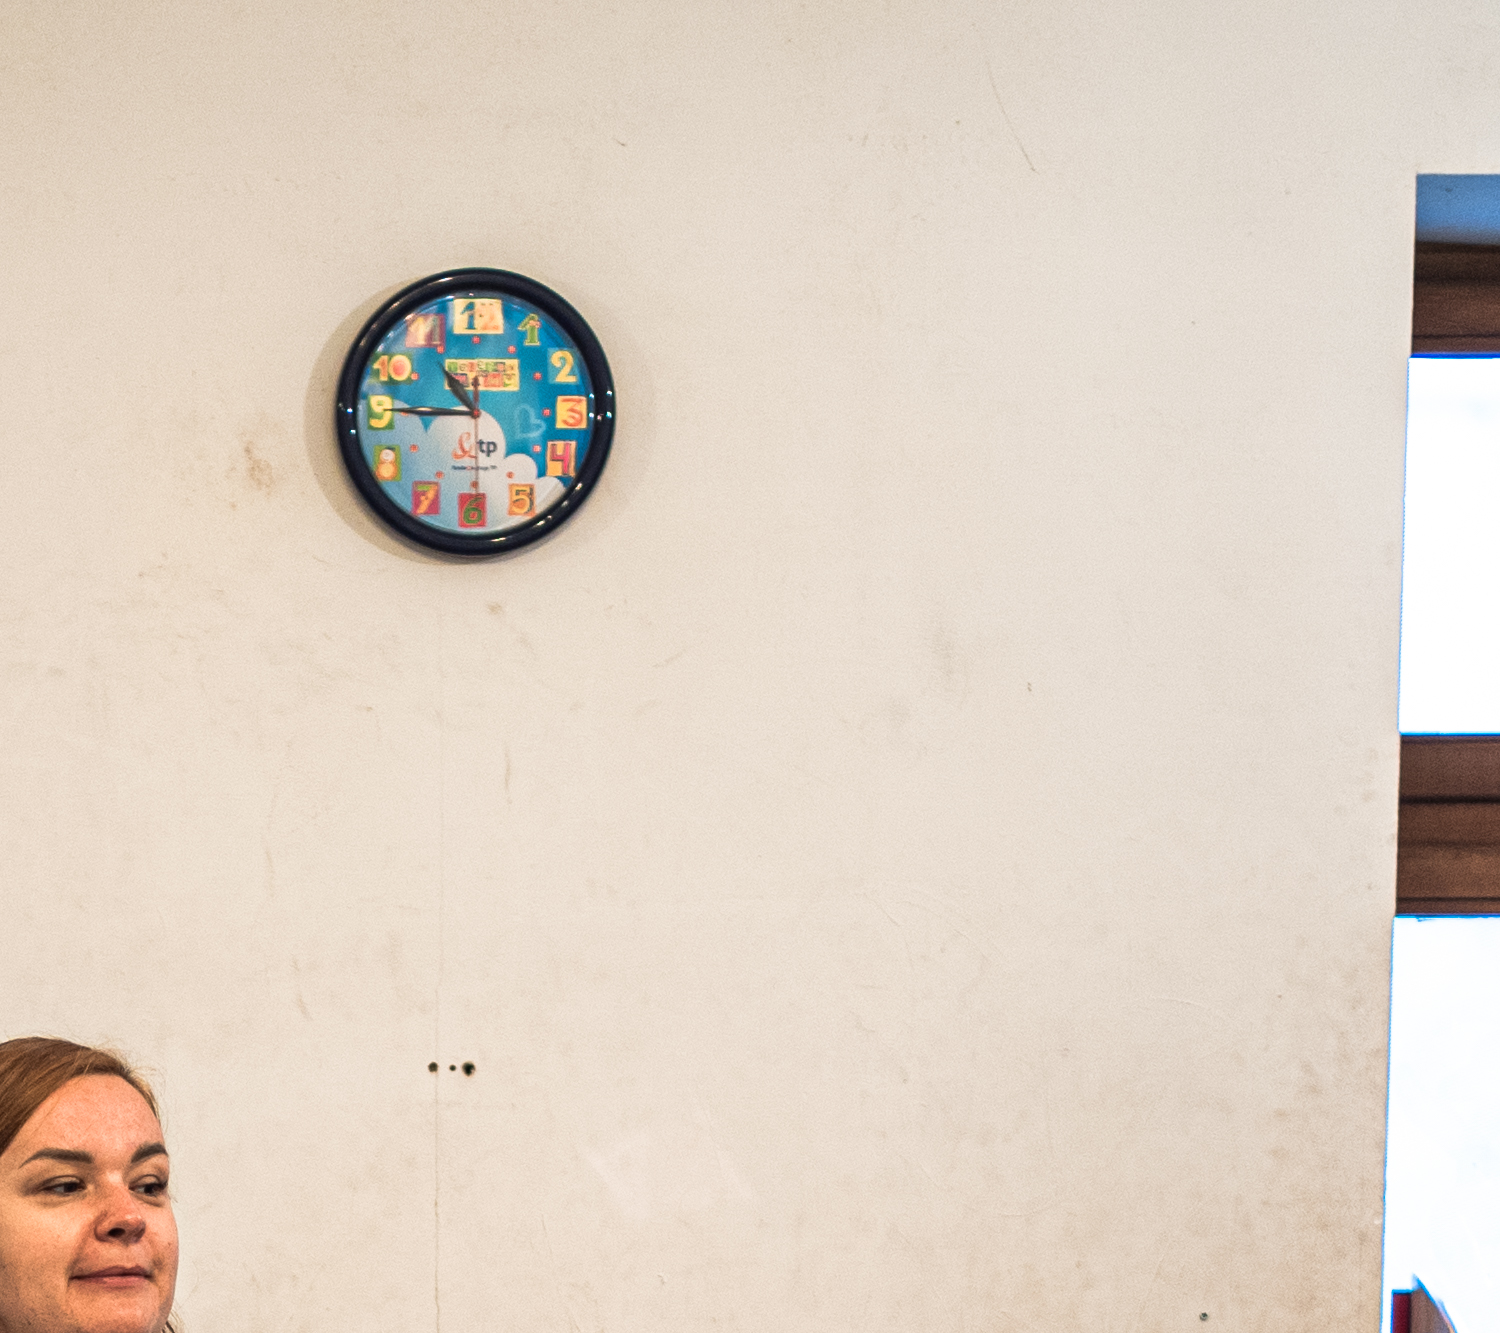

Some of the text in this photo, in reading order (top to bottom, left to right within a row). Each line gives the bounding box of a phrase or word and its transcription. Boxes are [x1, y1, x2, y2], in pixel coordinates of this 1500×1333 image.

[458, 300, 502, 333] 12
[373, 355, 412, 381] 10
[551, 351, 576, 382] 2
[369, 397, 394, 428] 9
[561, 398, 583, 427] 3
[550, 443, 571, 474] 4
[416, 483, 438, 513] 7
[462, 496, 483, 524] 6
[512, 487, 532, 513] 5
